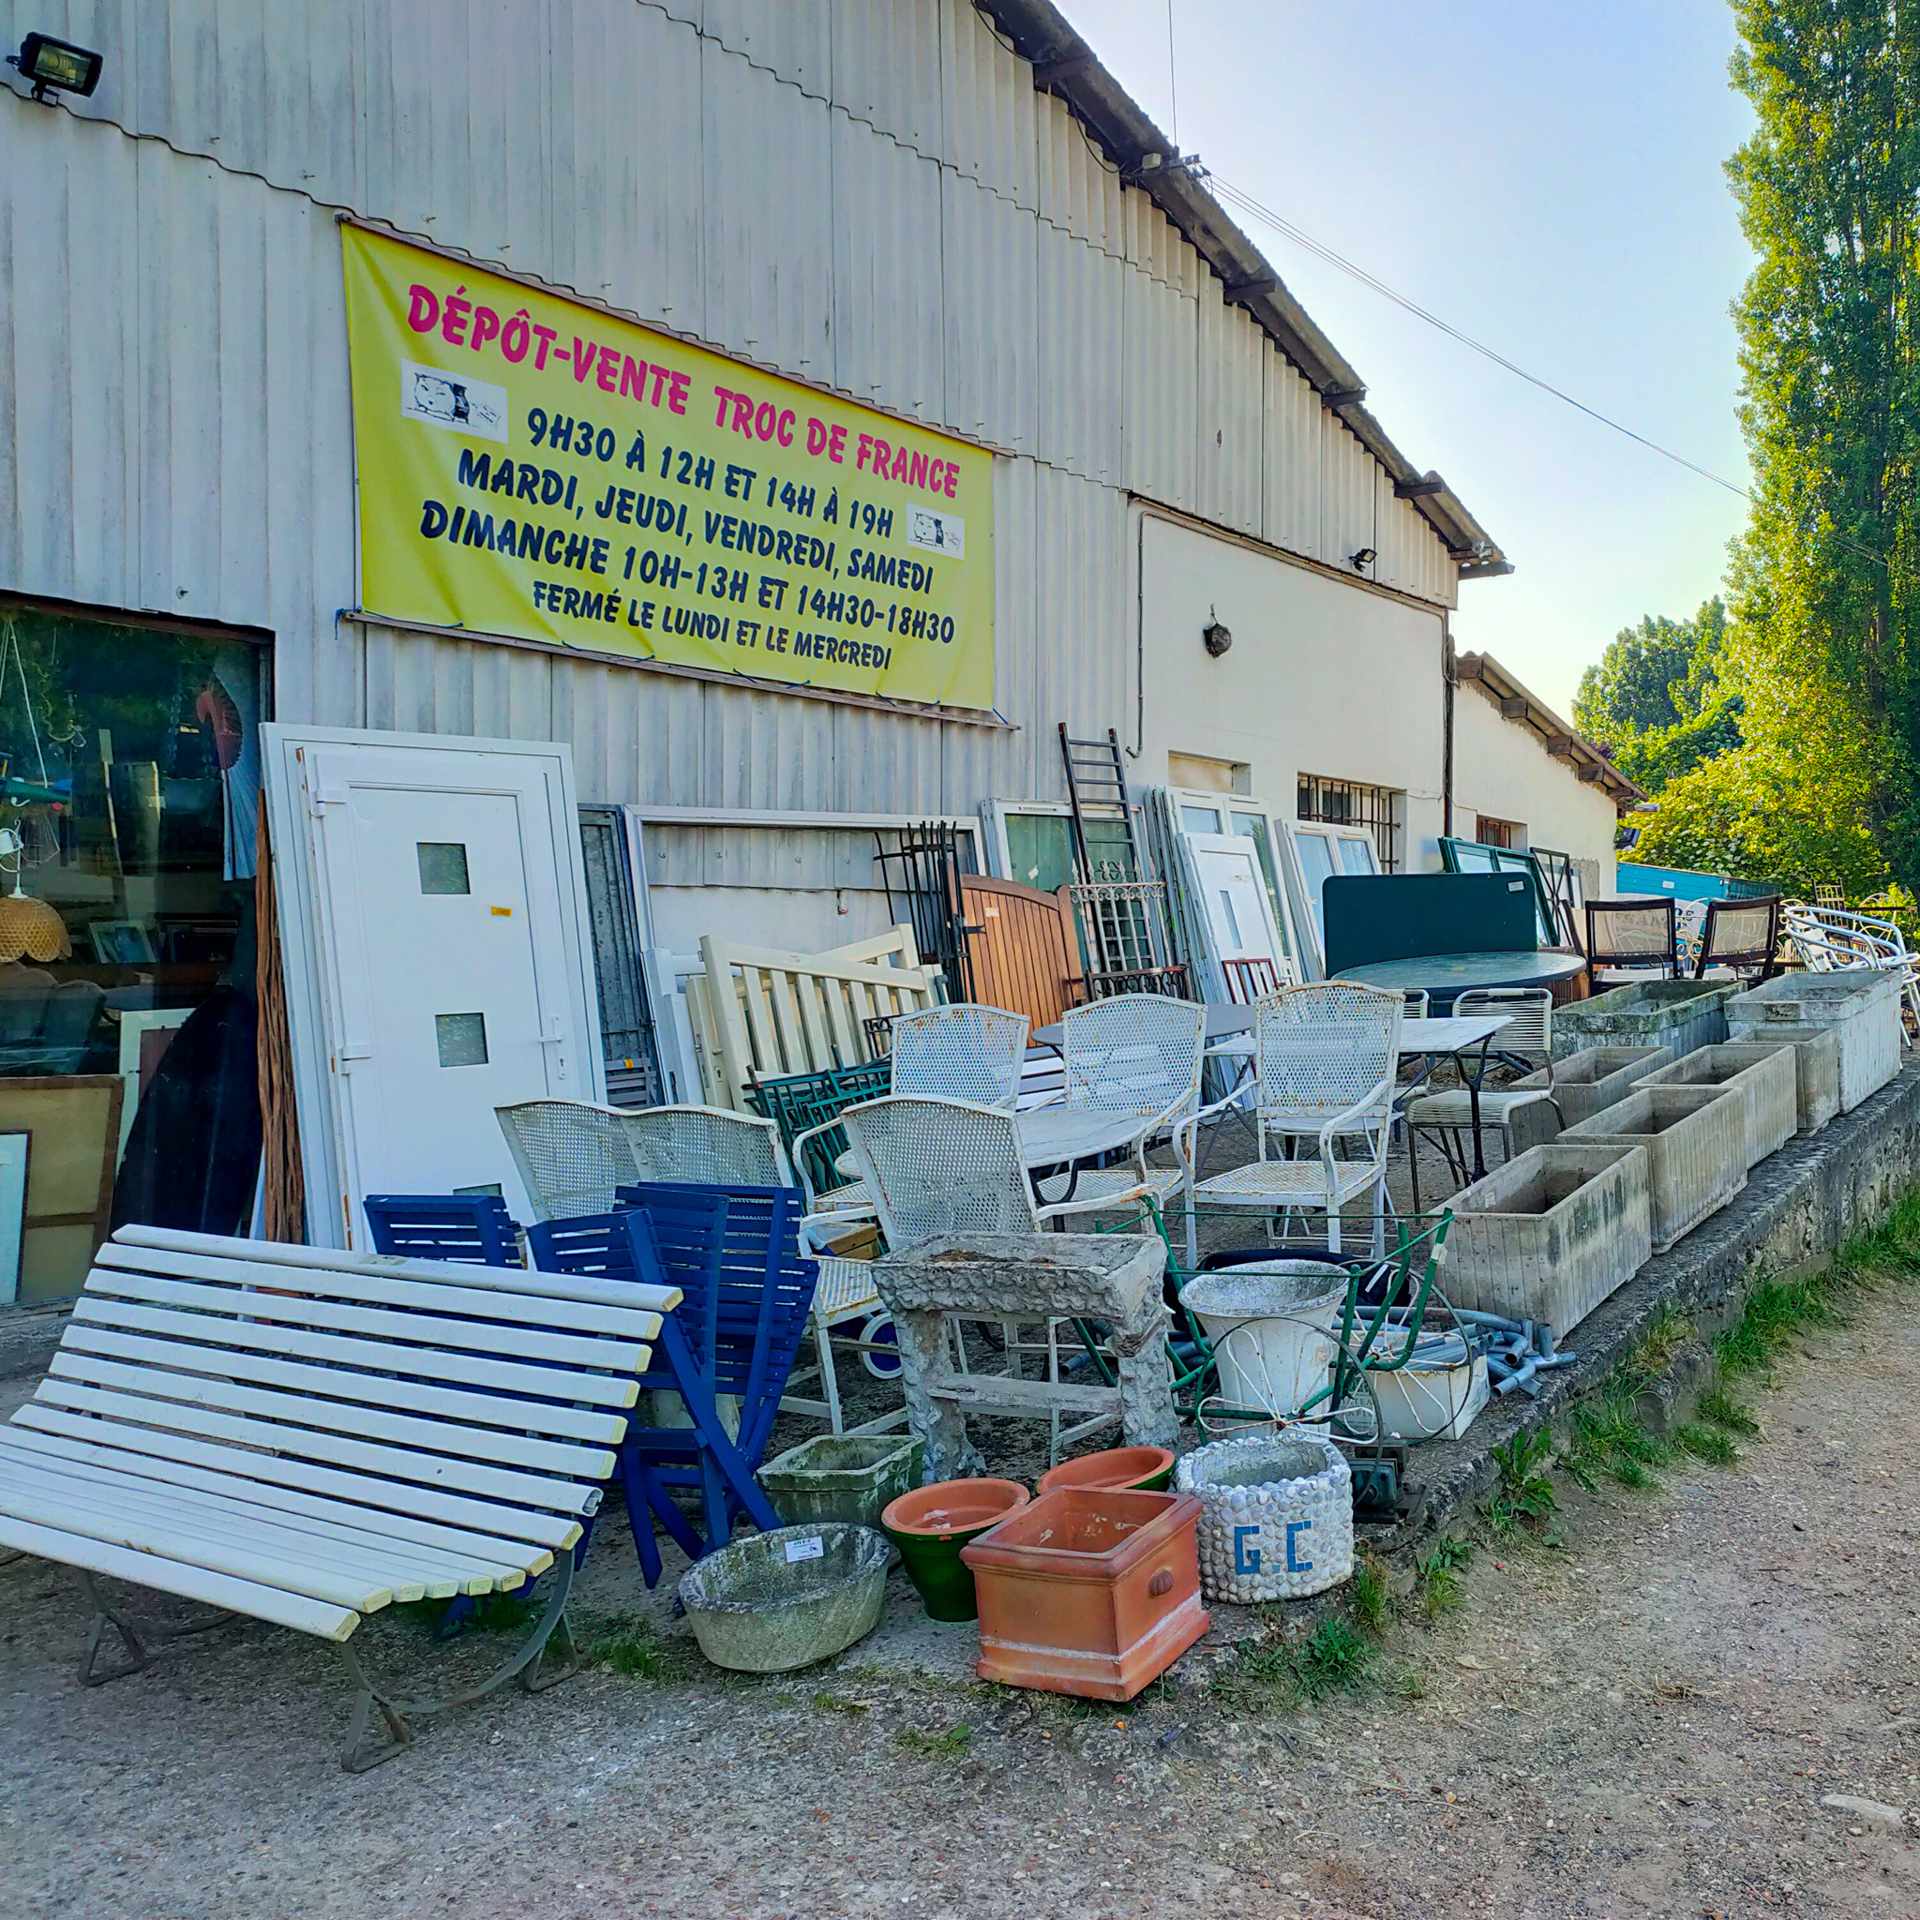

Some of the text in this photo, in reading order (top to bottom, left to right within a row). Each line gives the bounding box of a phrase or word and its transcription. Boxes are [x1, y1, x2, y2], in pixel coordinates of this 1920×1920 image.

[407, 284, 961, 498] DÉPÔT-VENTE TROC DE FRANCE
[458, 448, 933, 594] MARDI, JEUDI, VENDREDI, SAMEDI
[527, 407, 893, 538] 9H30 À 12H ET 14H À 19H
[420, 500, 955, 644] DIMANCHE 10H-13H ET 14H30-18H30
[533, 580, 892, 670] FERMÉ LE LUNDI ET LE MERCREDI
